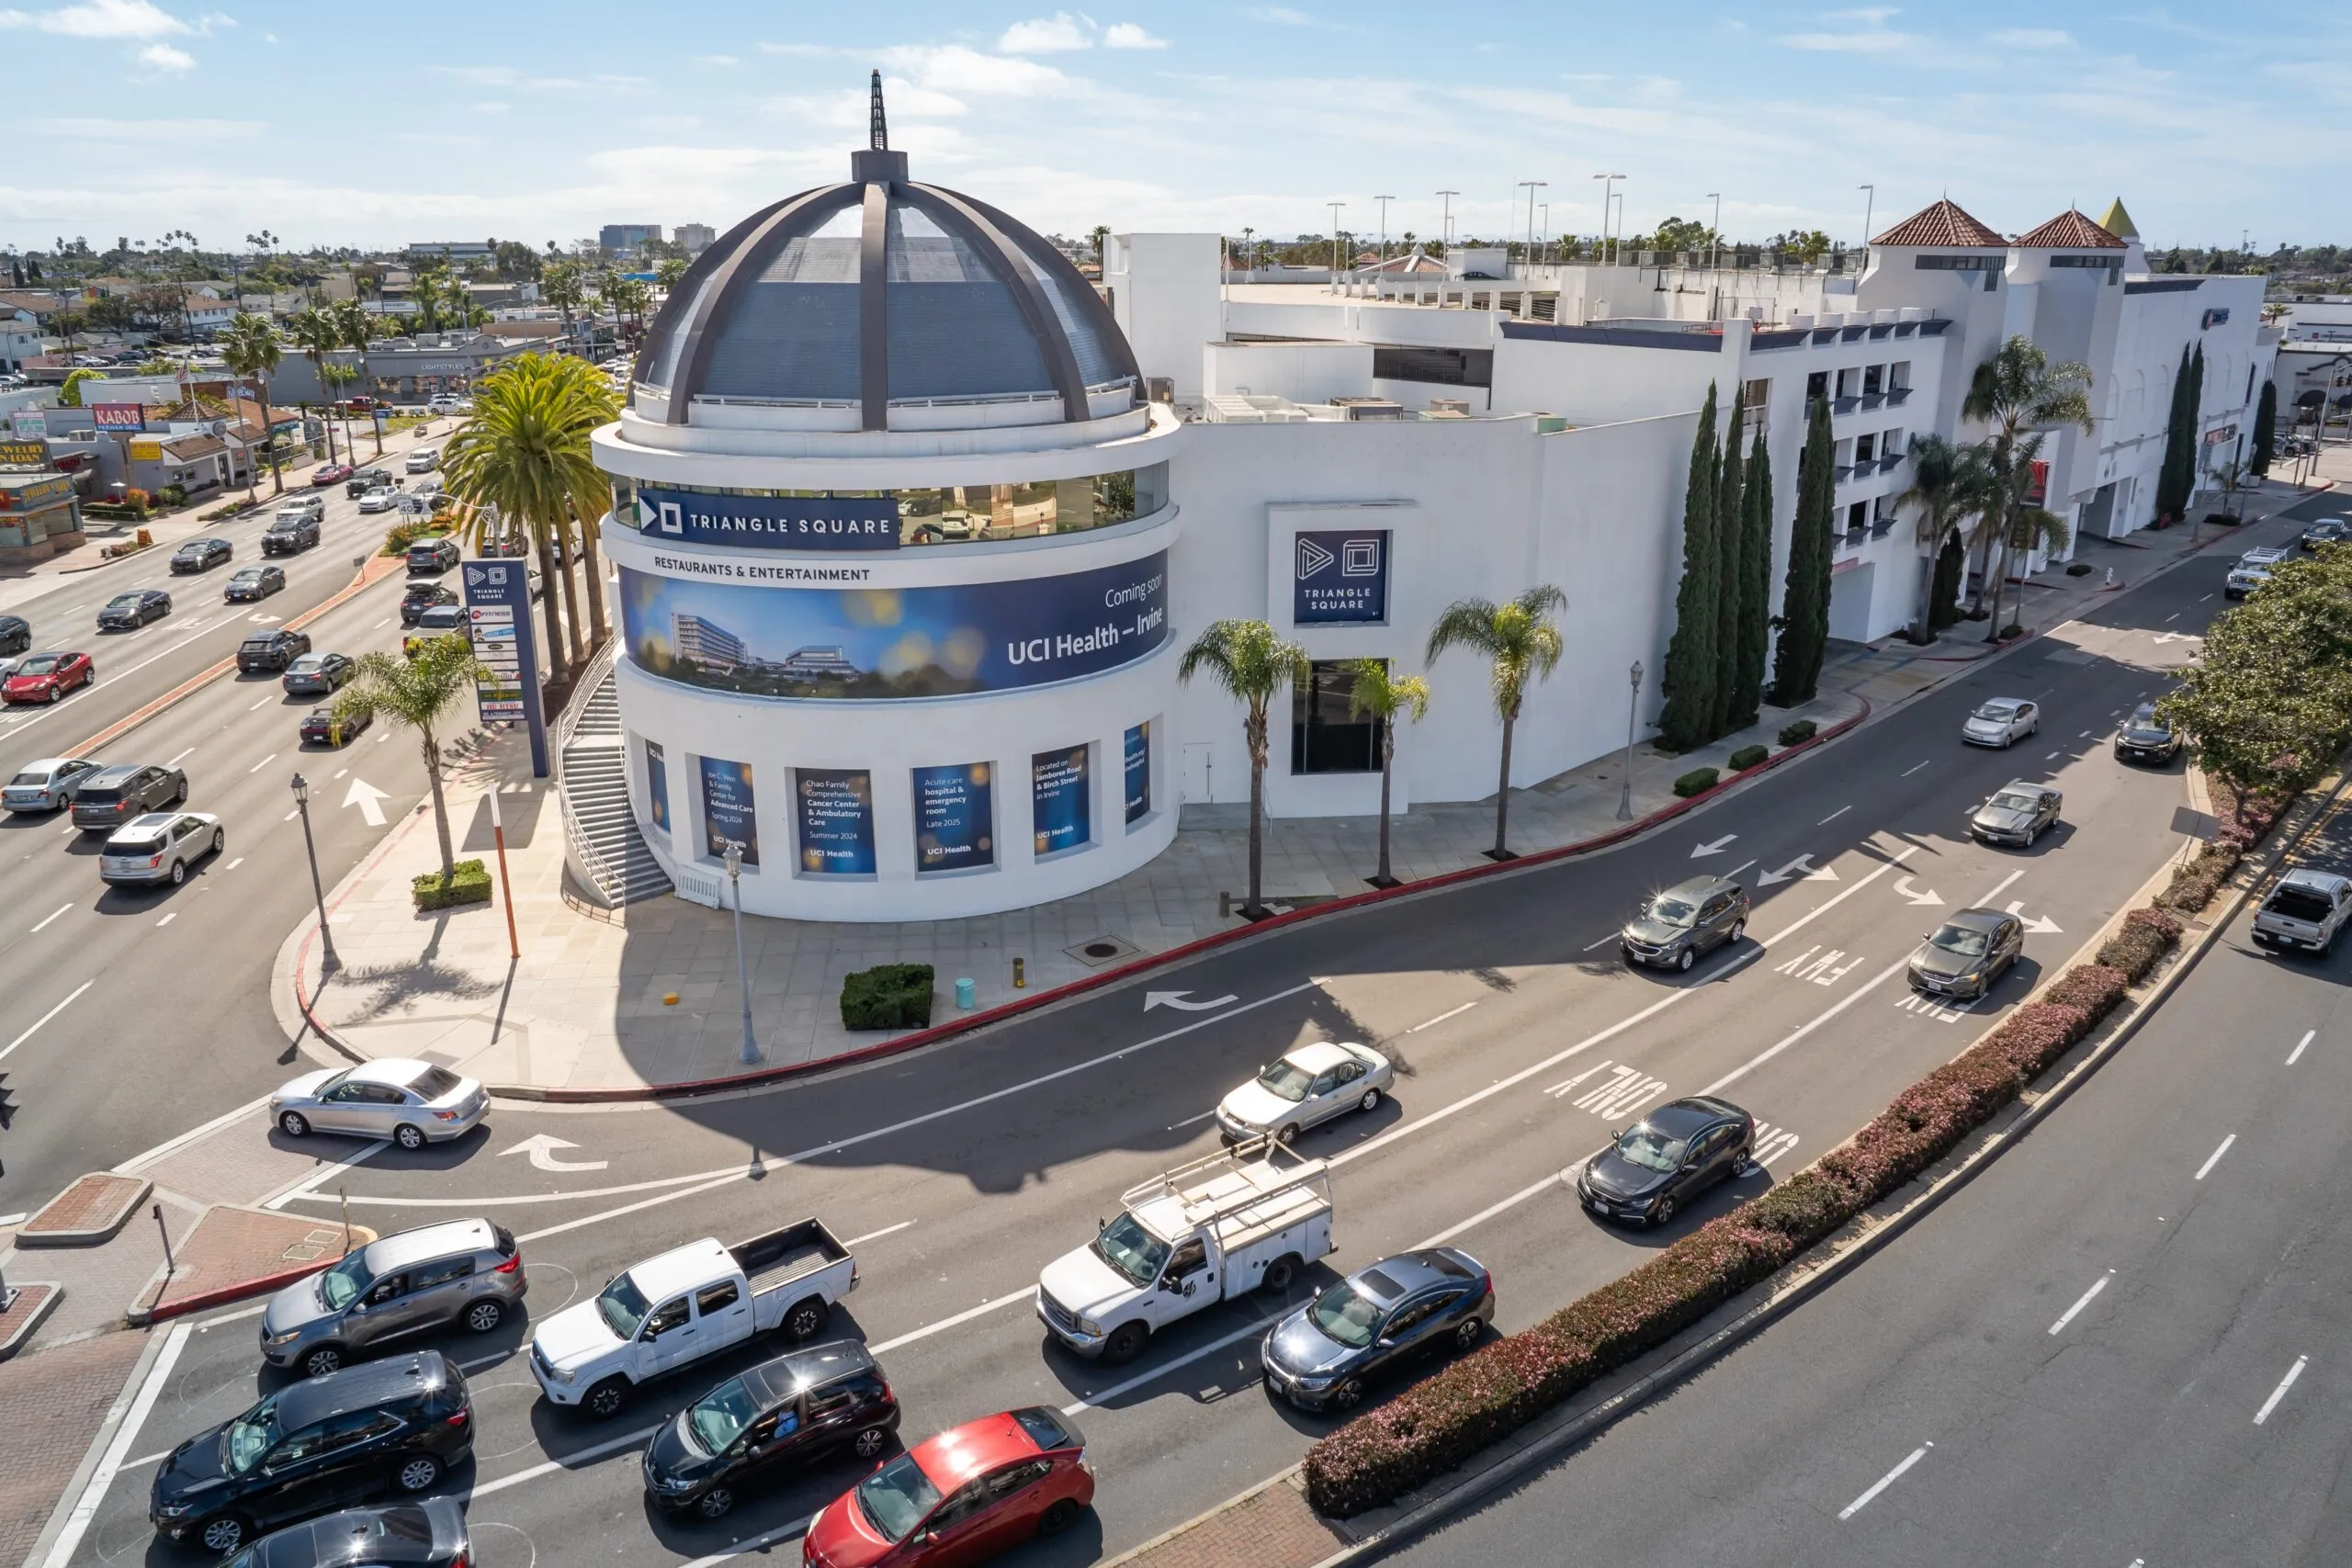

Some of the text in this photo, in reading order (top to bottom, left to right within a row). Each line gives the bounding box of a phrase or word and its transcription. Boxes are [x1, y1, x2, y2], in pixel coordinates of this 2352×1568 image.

[96, 410, 140, 424] KABOB
[10, 454, 40, 463] LOAN
[690, 514, 889, 535] TRIANGLE SQUARE
[654, 557, 870, 581] RESTAURANTS & ENTERTAINMENT
[1105, 573, 1162, 607] Coming soon
[1305, 588, 1371, 598] TRIANGLE
[1311, 601, 1363, 610] SQUARE
[1008, 637, 1049, 664] UCI
[1057, 623, 1118, 658] Health
[1137, 606, 1162, 636] Irvine
[1036, 760, 1059, 772] Located
[723, 773, 736, 782] Wen
[1036, 764, 1082, 782] Jamboree Road
[715, 781, 731, 791] Family
[826, 781, 849, 789] Family
[924, 778, 946, 786] Acute
[1044, 780, 1059, 789] Birch
[1060, 775, 1078, 785] Street
[709, 790, 727, 800] Center
[807, 789, 862, 798] Comprehensive
[924, 786, 956, 796] hospital
[1044, 789, 1060, 798] Irvine
[710, 799, 753, 813] Advanced Care
[808, 799, 860, 808] Cancer Center
[925, 796, 967, 806] emergency
[1130, 795, 1143, 808] Health
[712, 812, 742, 824] Spring 2024
[816, 809, 862, 818] Ambulatory
[944, 818, 961, 827] 2025
[809, 831, 839, 840] Summer
[1037, 825, 1074, 840] UCI Health
[713, 835, 724, 843] UCI
[809, 849, 854, 858] UCI Health
[945, 844, 971, 853] Health
[1544, 1059, 1668, 1121] ONLY
